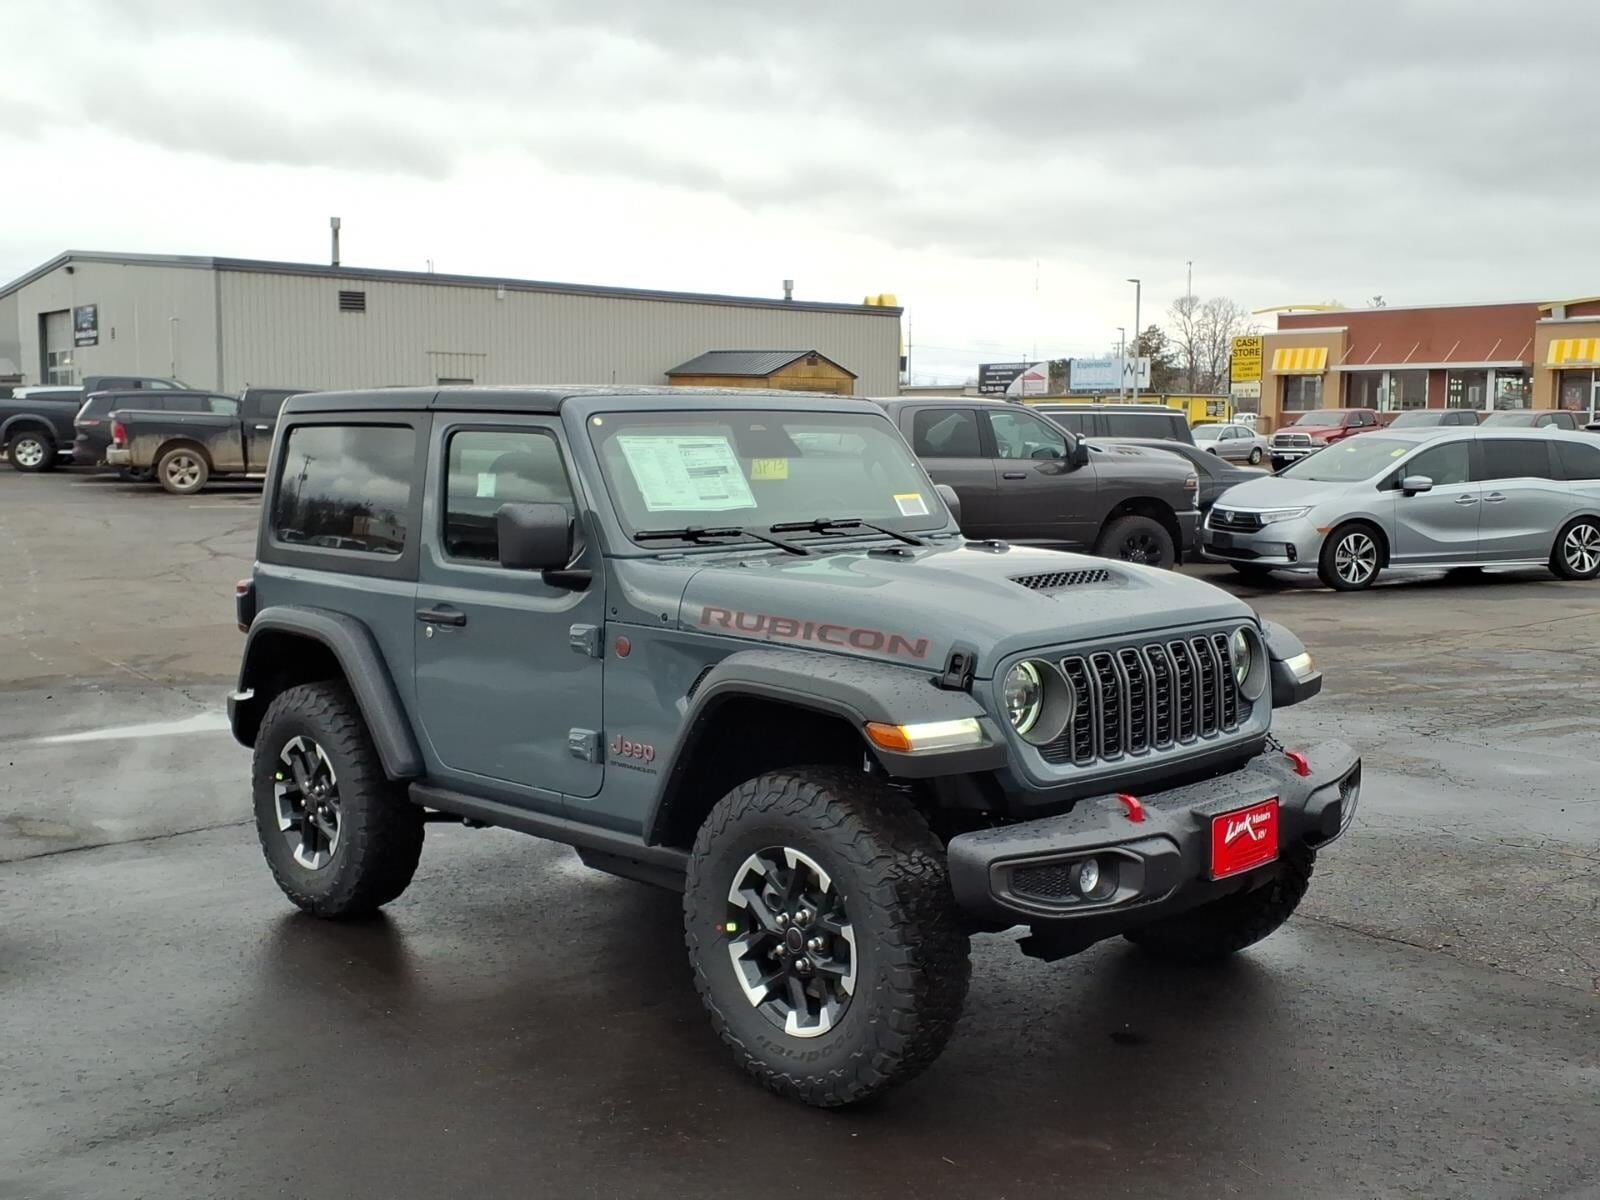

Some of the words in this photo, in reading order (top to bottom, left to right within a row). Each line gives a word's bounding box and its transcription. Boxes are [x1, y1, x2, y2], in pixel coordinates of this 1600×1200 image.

[1232, 348, 1260, 357] STORE
[1236, 339, 1258, 347] CASH
[1076, 361, 1113, 370] Experience
[700, 606, 930, 660] RUBICON
[608, 734, 656, 764] Jeep
[1225, 814, 1257, 843] Link
[1252, 811, 1271, 822] Motors
